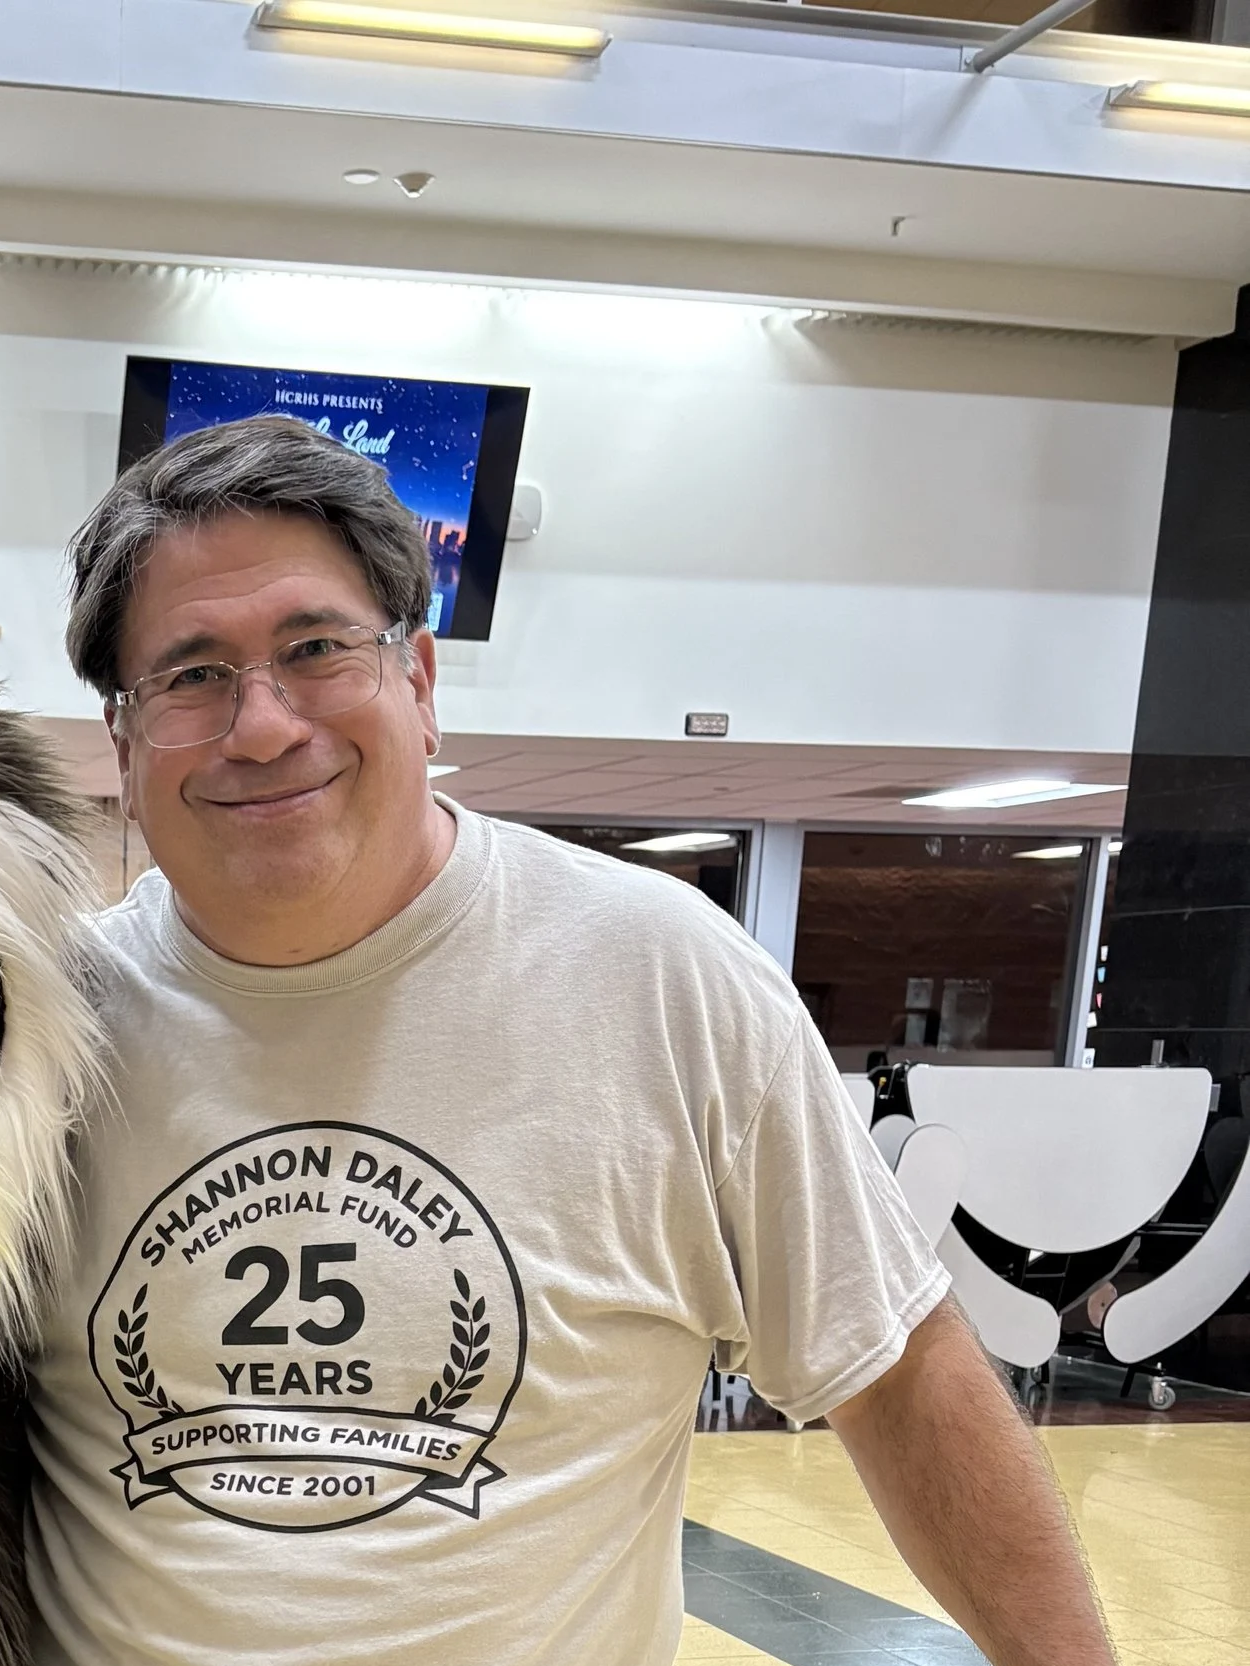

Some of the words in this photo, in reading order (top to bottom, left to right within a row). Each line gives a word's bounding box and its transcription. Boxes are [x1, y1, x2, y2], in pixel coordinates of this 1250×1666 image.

[322, 394, 384, 413] PRESENTS
[141, 1146, 332, 1267] SHANNON
[346, 1151, 473, 1246] DALEY
[183, 1191, 331, 1264] MEMORIAL
[340, 1196, 418, 1248] FUND
[222, 1243, 365, 1346] 25
[216, 1360, 373, 1395] YEARS
[152, 1423, 320, 1454] SUPPORTING
[330, 1428, 462, 1461] FAMILIES
[210, 1473, 292, 1496] SINCE
[303, 1476, 376, 1497] 2001
